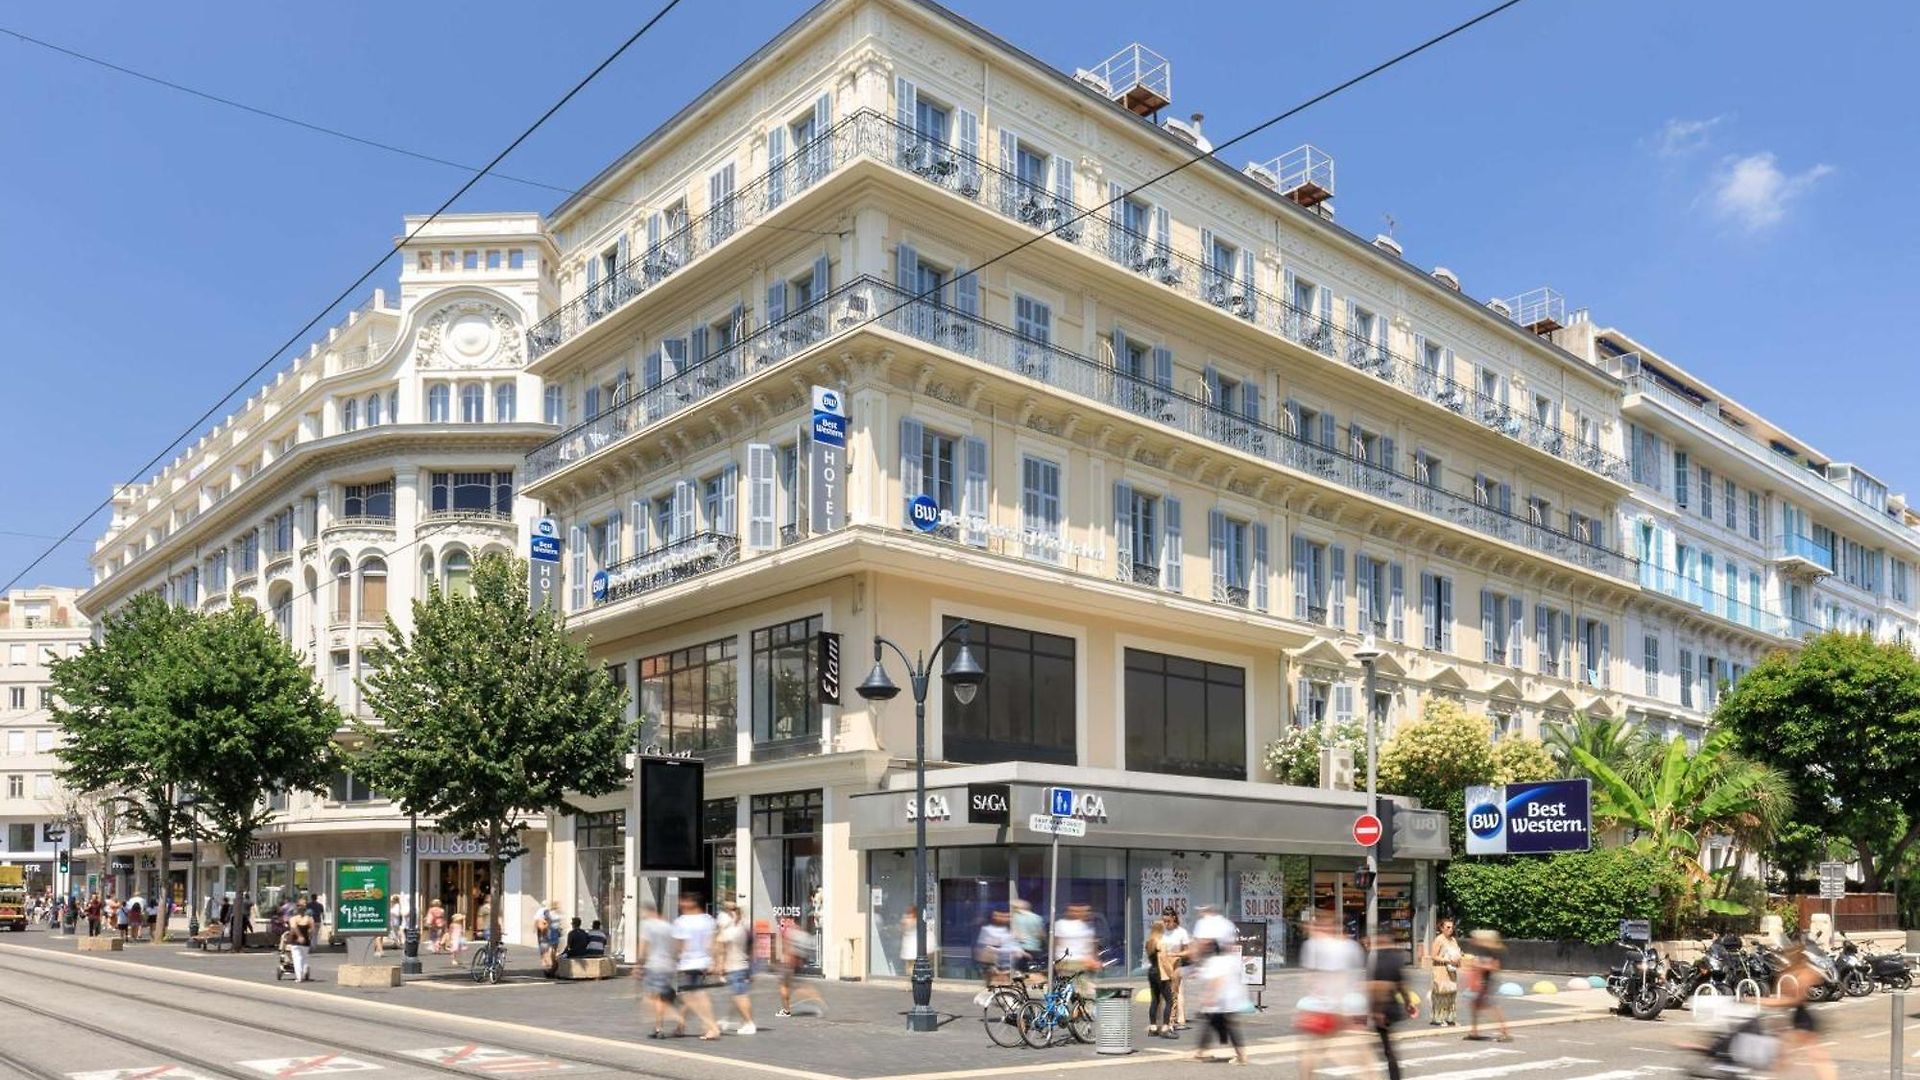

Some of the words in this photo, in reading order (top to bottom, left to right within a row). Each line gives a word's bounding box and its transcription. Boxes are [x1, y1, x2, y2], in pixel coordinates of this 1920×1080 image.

[816, 424, 843, 438] Western
[822, 419, 838, 429] Best
[823, 450, 835, 532] HOTEL
[913, 503, 937, 522] BW
[540, 565, 550, 594] HO
[593, 578, 606, 593] BW
[906, 795, 951, 819] SGA
[973, 793, 1008, 812] SAGA
[1071, 793, 1107, 817] AGA
[1527, 801, 1567, 817] Best
[1472, 813, 1500, 830] BW
[772, 906, 801, 917] SOLDES
[1246, 899, 1281, 916] SOLDES
